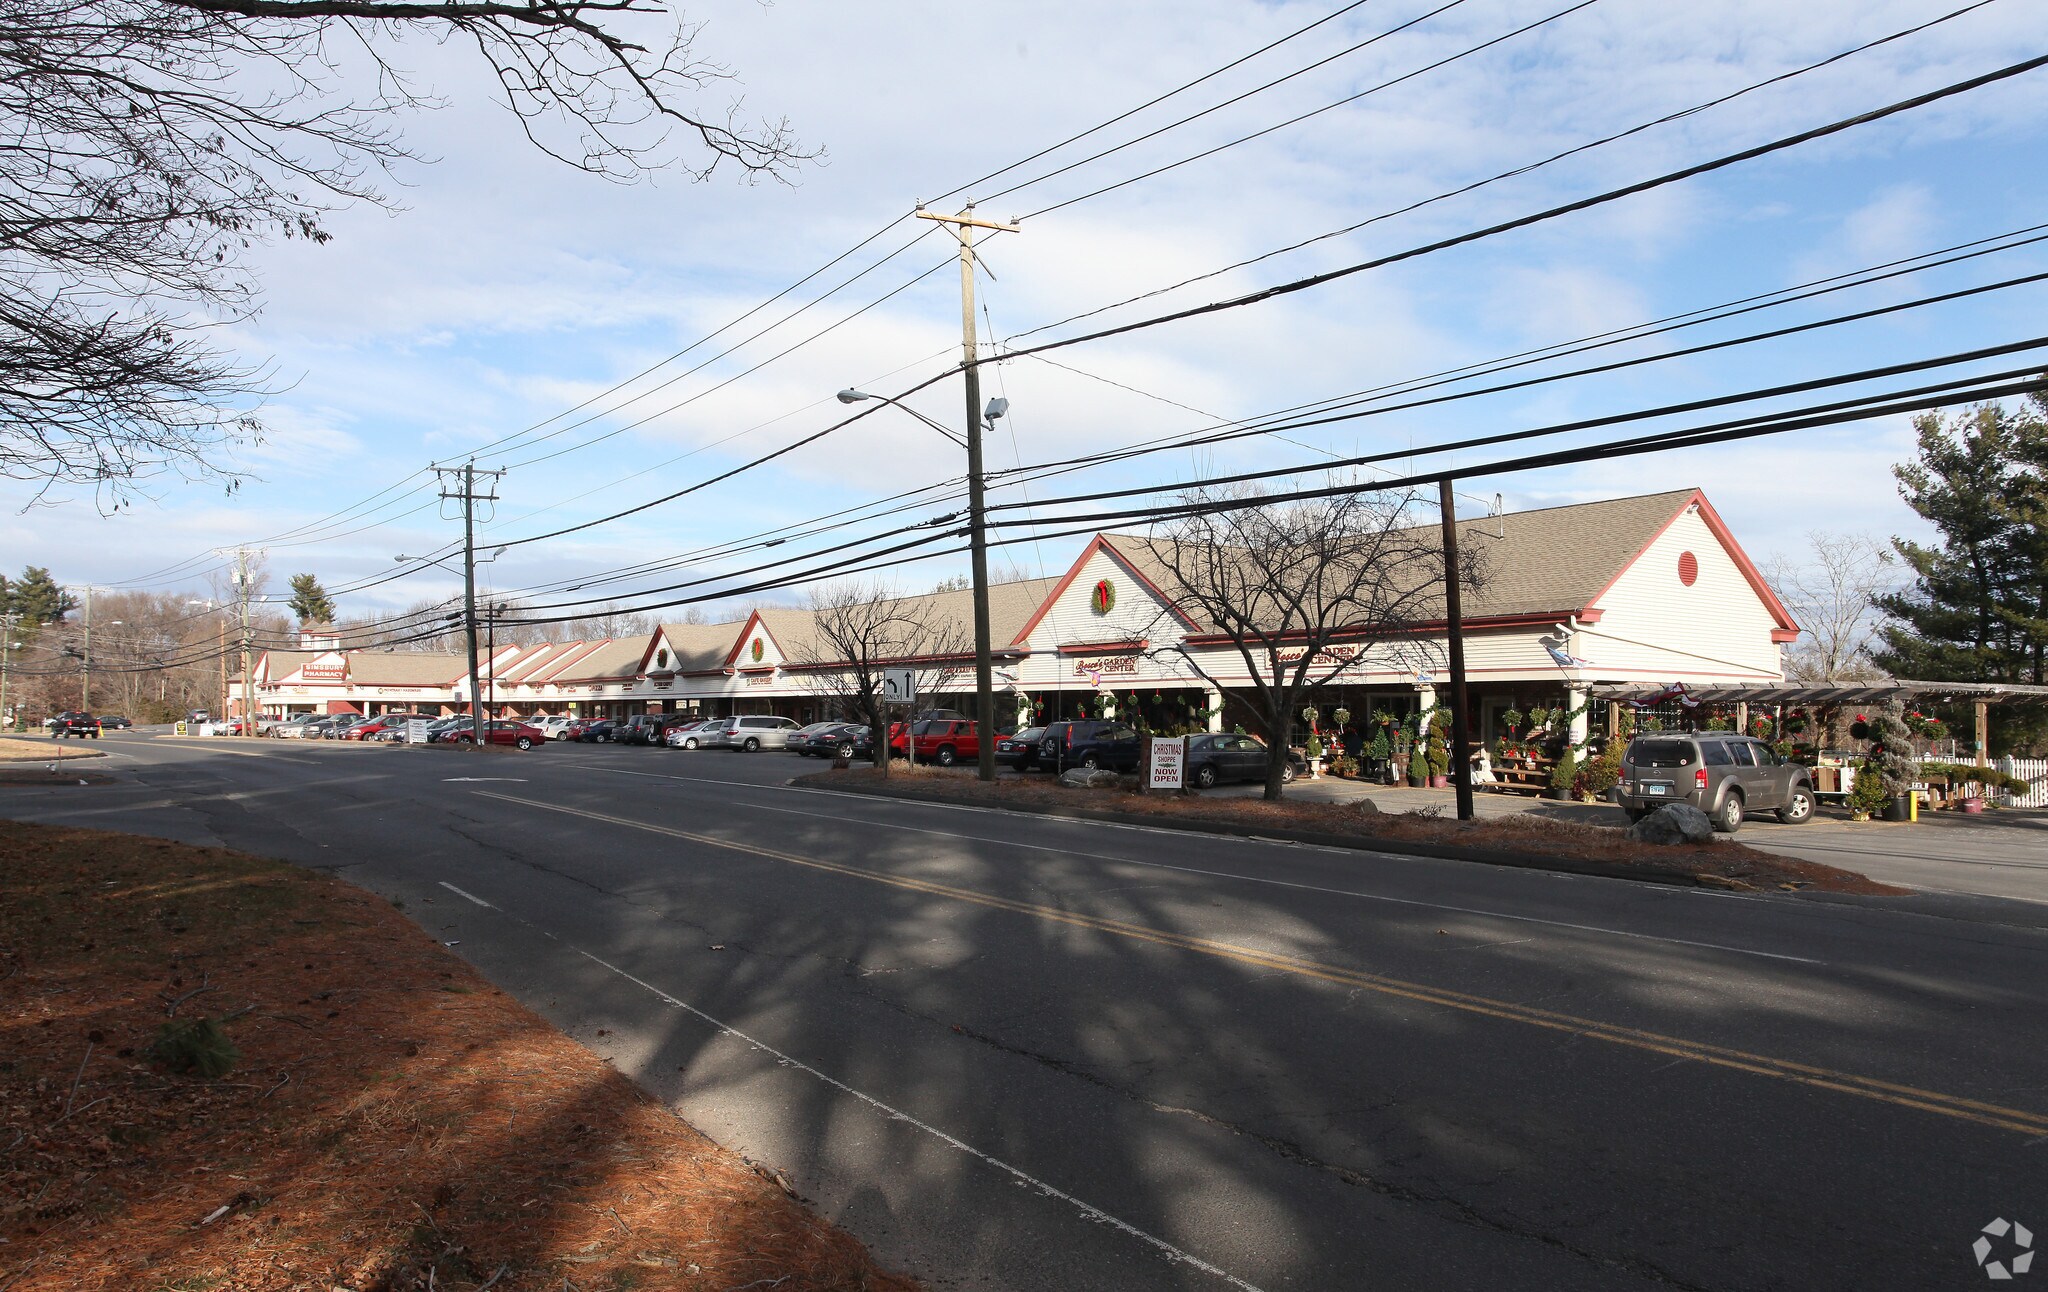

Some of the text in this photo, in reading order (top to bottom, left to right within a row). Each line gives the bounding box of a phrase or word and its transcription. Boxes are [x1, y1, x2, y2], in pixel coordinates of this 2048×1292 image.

[1075, 657, 1136, 673] Bosco's GARDEN
[1104, 664, 1136, 673] CENTER
[1153, 743, 1182, 755] CHRISTMAS
